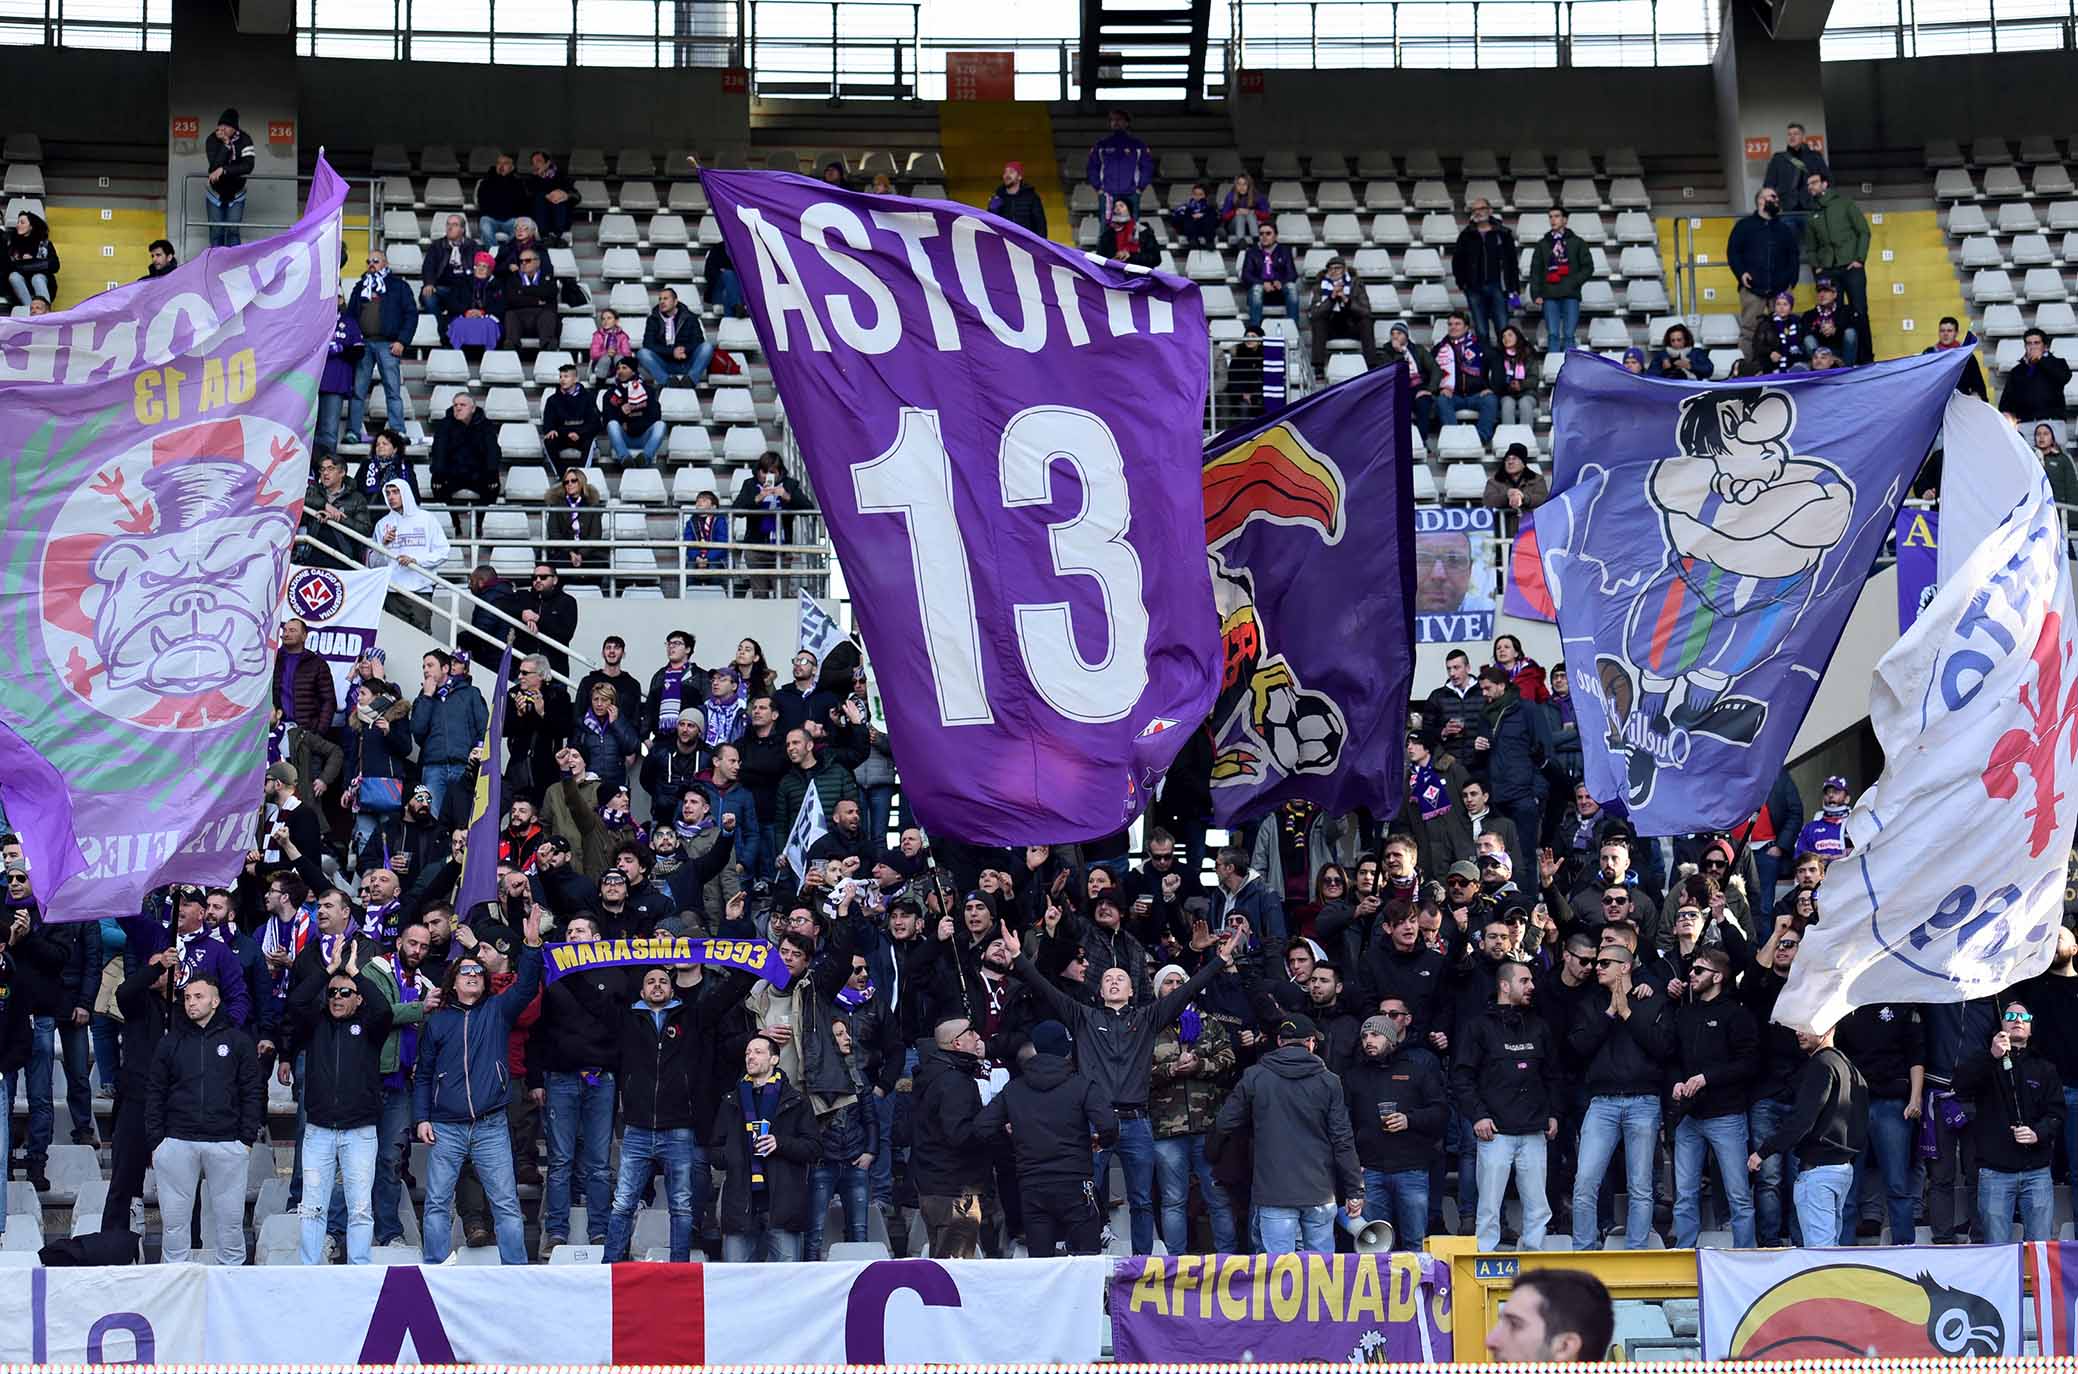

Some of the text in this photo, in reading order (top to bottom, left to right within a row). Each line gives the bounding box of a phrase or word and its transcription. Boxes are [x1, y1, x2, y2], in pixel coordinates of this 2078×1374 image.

[175, 121, 198, 132] 235
[270, 127, 293, 137] 236
[1746, 143, 1769, 153] 237
[1416, 508, 1494, 532] DDO
[1902, 513, 1938, 548] A
[850, 404, 1149, 726] 13
[310, 568, 337, 583] CALCIO
[1416, 614, 1493, 642] IVE!
[551, 937, 769, 972] MARASMA 1993
[1479, 1260, 1516, 1276] A 14
